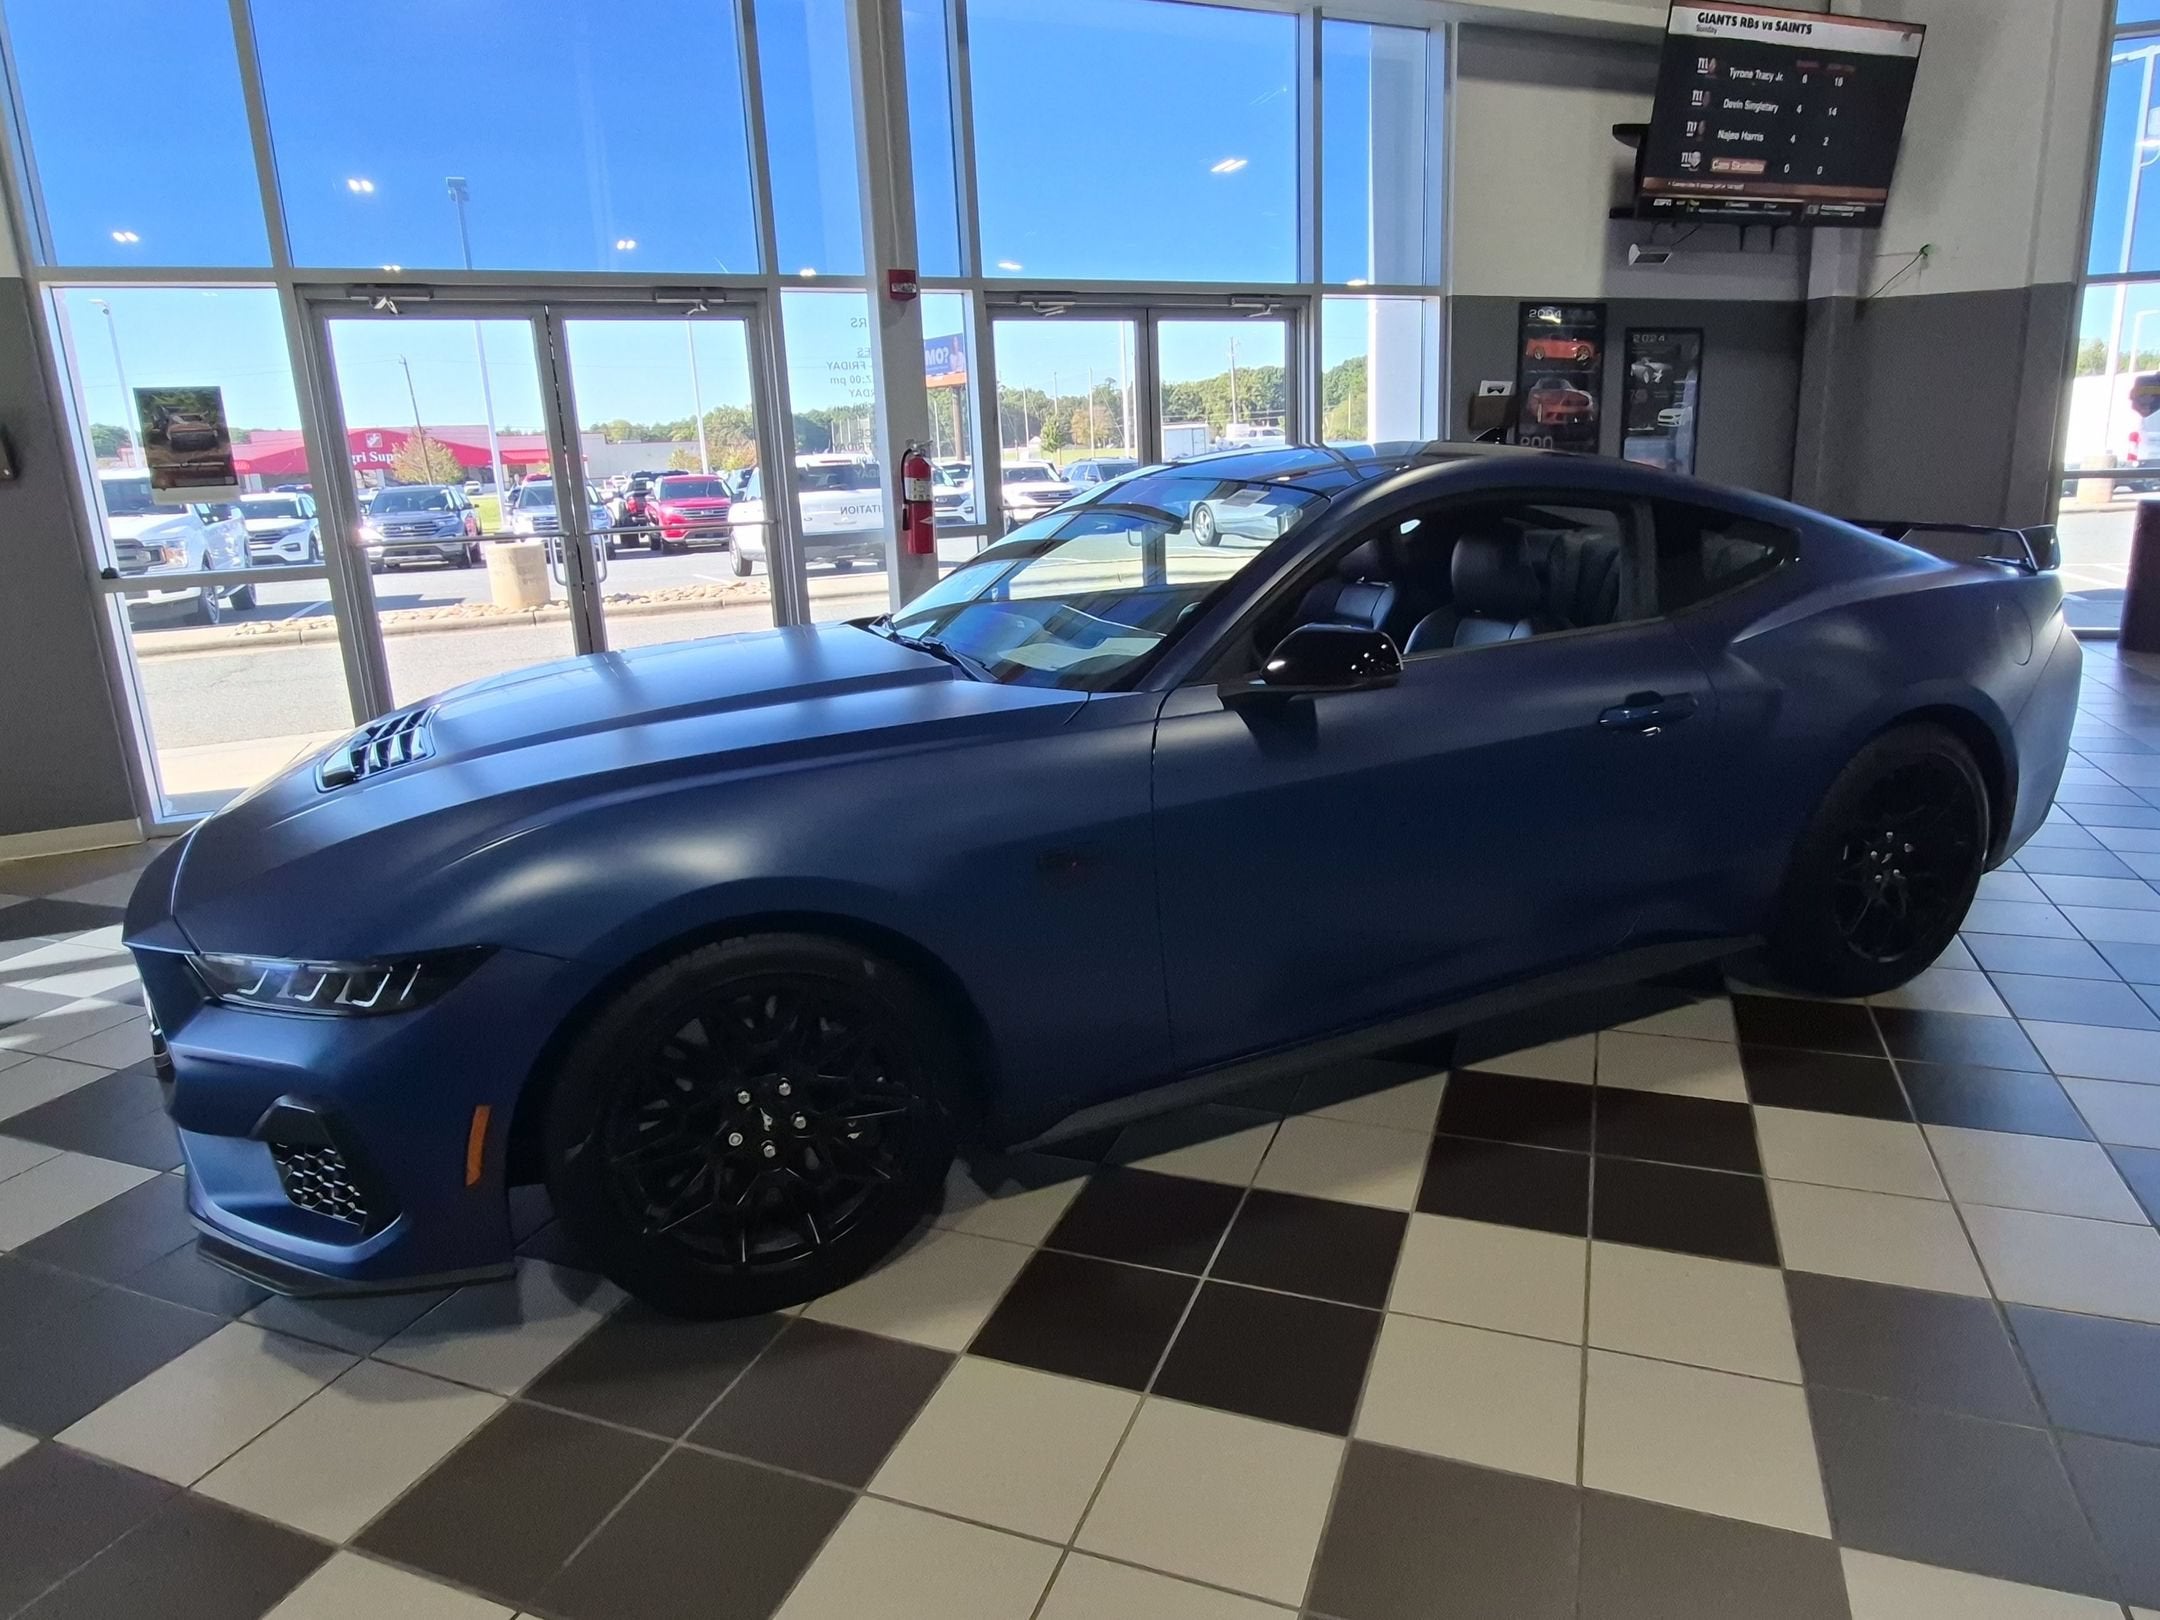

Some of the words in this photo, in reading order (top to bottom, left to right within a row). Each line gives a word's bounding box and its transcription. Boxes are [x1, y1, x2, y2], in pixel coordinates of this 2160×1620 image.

[1697, 12, 1738, 27] GIANTS
[1740, 17, 1759, 29] RBs
[1762, 22, 1773, 31] vs
[1775, 21, 1813, 35] SAINTS
[1822, 136, 1829, 146] 2
